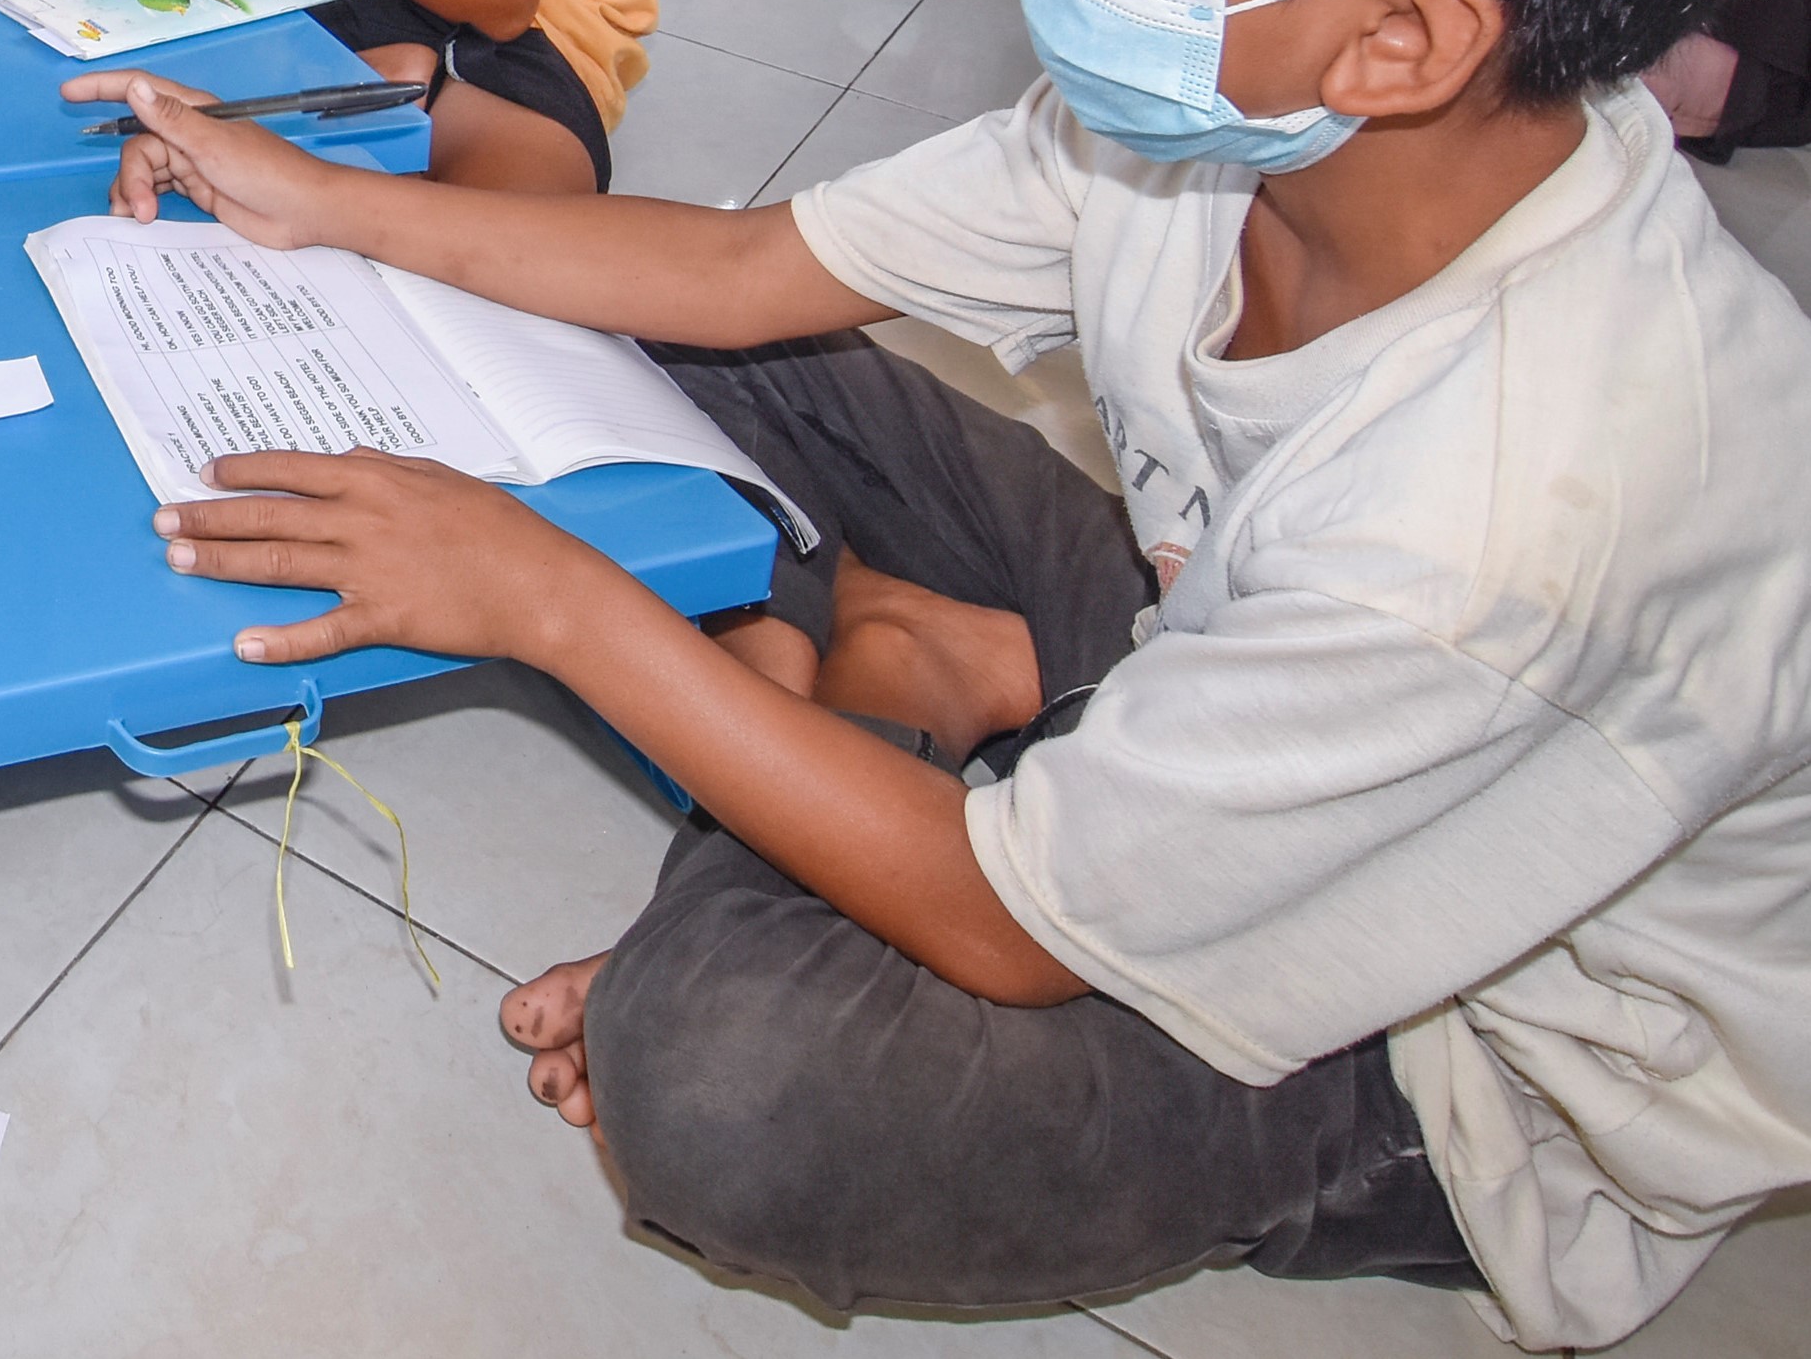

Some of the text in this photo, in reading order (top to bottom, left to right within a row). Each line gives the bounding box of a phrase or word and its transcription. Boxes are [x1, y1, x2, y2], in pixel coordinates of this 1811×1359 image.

[106, 267, 117, 283] TOO
[126, 263, 139, 284] YOU?
[134, 285, 150, 303] HELP
[212, 253, 277, 335] YOU CAN GO FROM THE HOTEL
[259, 279, 271, 290] AND
[112, 286, 134, 319] MORNING
[161, 253, 225, 345] YOU CAN GO SOUTH AND COME
[190, 251, 258, 340] IT WAS BESIDE NOVOTEL HOTEL
[269, 290, 295, 321] PLEASURE
[296, 284, 335, 327] GOOD BYE TOO
[148, 307, 160, 321] CAN
[176, 310, 193, 330] KNOW
[196, 289, 237, 343] TO SEGER BEACH
[262, 302, 290, 334] LEFT SIDE
[288, 299, 315, 330] WELCOME
[128, 321, 145, 341] GOOD
[155, 322, 170, 337] HOW
[293, 321, 304, 332] MY
[191, 333, 205, 347] YES
[311, 348, 327, 362] FOR
[322, 362, 342, 382] MUCH
[211, 378, 225, 391] THE
[247, 375, 262, 391] GO?
[274, 370, 299, 399] BEACH?
[314, 384, 330, 399] THE
[336, 382, 349, 393] SO
[220, 393, 242, 419] WHERE
[233, 391, 246, 403] IS?
[257, 391, 268, 401] TO
[325, 398, 337, 410] OF
[344, 393, 360, 409] YOU
[177, 405, 203, 439] MORNING
[197, 392, 240, 451] ASK YOUR HELP?
[240, 403, 261, 428] BEACH
[263, 403, 283, 423] HAVE
[293, 399, 315, 425] SEGER
[332, 410, 350, 429] SIDE
[237, 419, 257, 442] KNOW
[310, 425, 320, 434] IS
[355, 409, 379, 436] THANK
[367, 406, 403, 449] YOUR HELP
[391, 405, 425, 444] GOOD BYE
[279, 427, 292, 439] DO
[170, 437, 199, 474] PRACTICE
